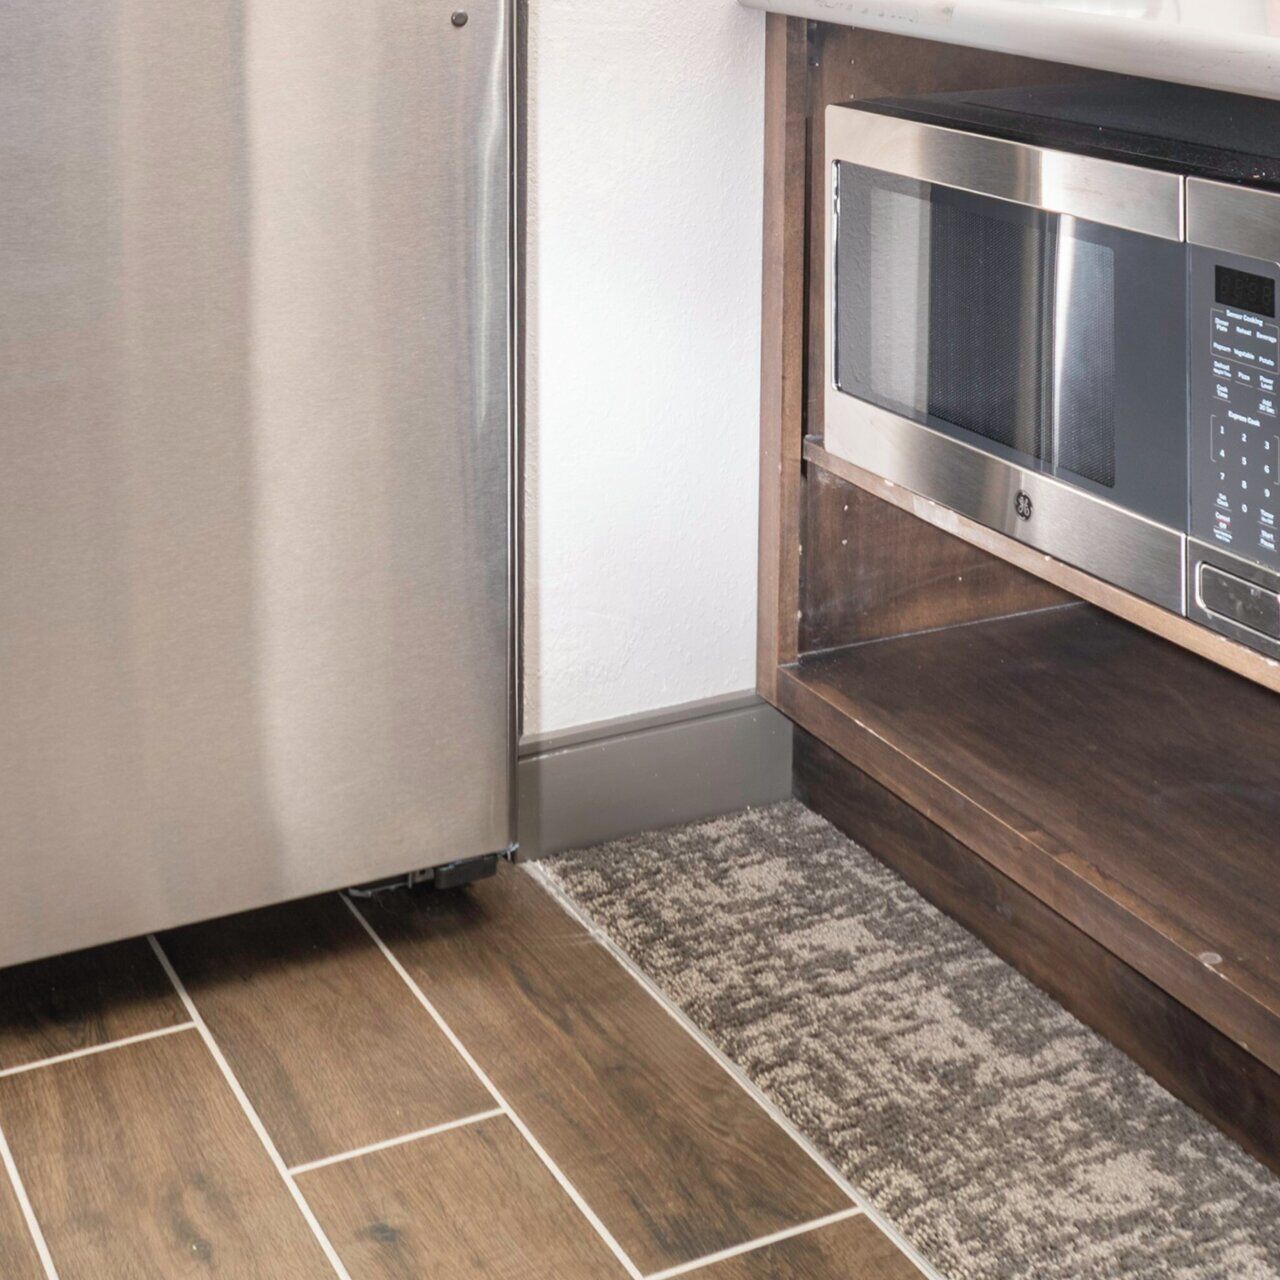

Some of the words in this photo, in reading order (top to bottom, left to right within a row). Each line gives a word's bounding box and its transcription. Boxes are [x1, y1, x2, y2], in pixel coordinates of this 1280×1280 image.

[1243, 314, 1263, 327] Cooking
[1228, 410, 1247, 423] Express
[1247, 417, 1260, 427] Cook
